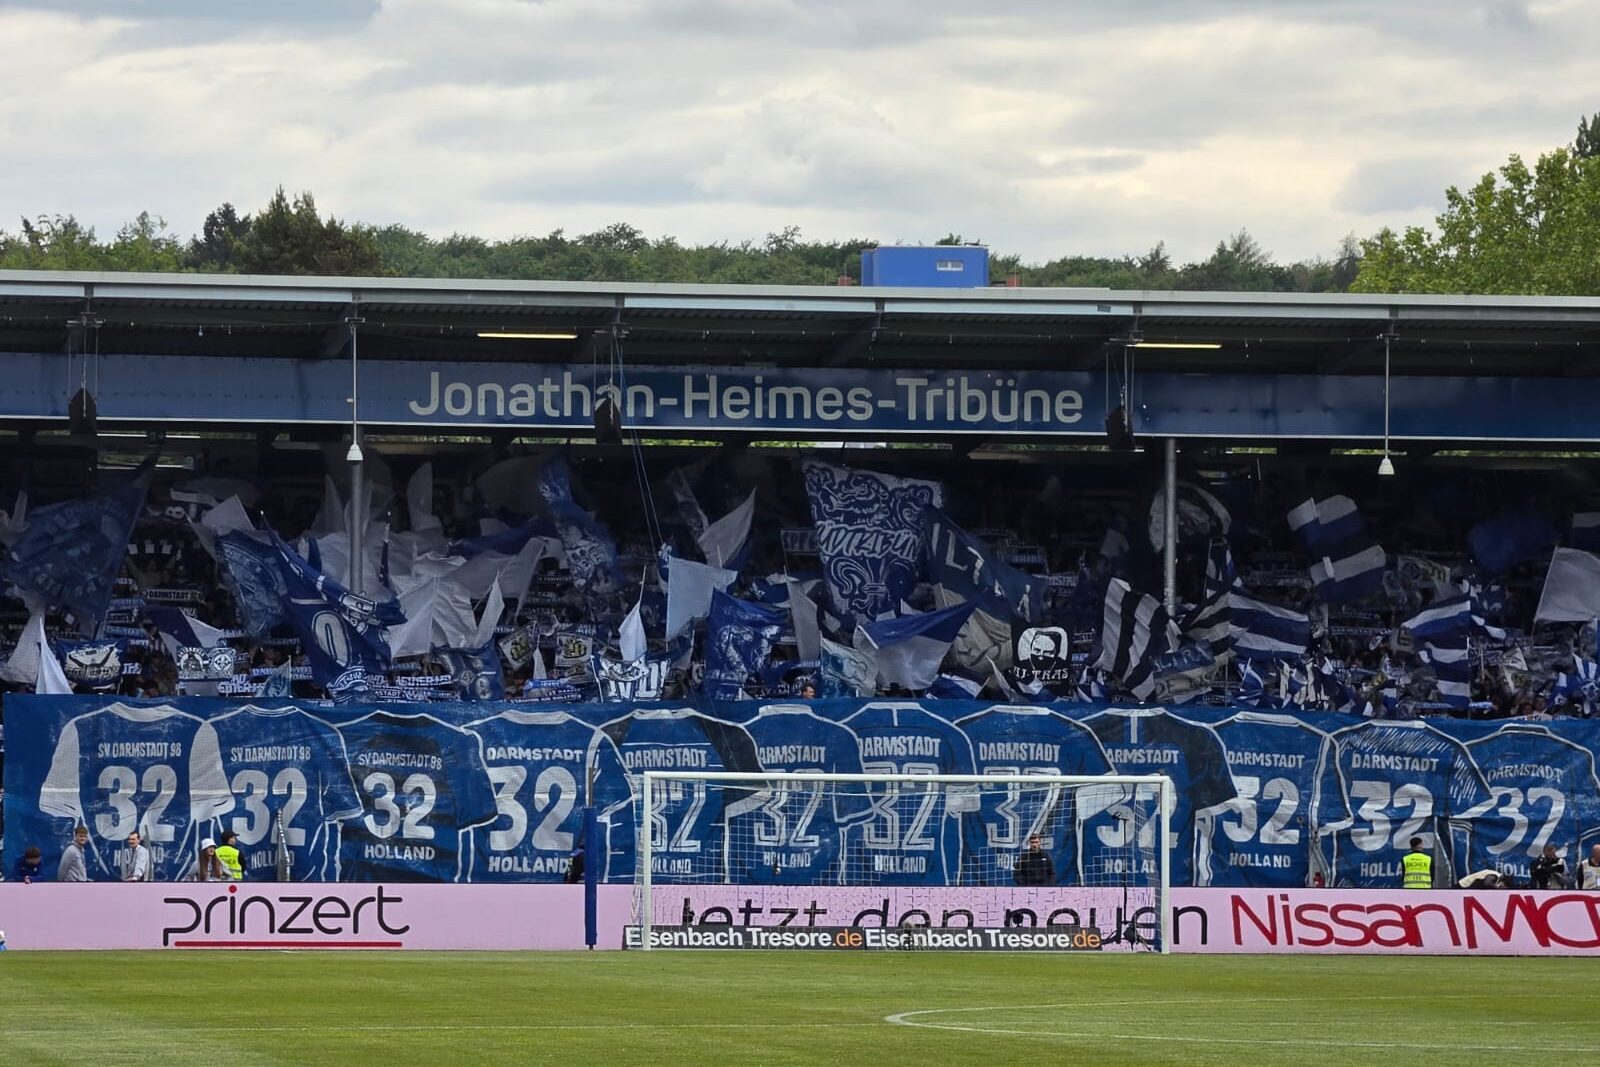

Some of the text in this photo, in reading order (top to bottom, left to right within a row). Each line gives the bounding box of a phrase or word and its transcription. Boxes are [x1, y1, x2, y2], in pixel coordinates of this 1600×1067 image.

[98, 741, 182, 758] SV DARMSTADT 98
[230, 746, 311, 762] SV DARMSTADT 98
[487, 747, 583, 763] DARMSTADT
[624, 749, 707, 768] DARMSTADT
[758, 745, 826, 765] ARMSTADT
[979, 742, 1061, 762] DARMSTADT
[1106, 749, 1179, 764] ARMSTADT
[358, 752, 442, 769] SV DARMSTADT 98
[1351, 753, 1439, 772] DARMSTADT
[1487, 764, 1565, 784] DARMSTADT
[95, 764, 177, 842] 32
[230, 767, 307, 846] 32
[363, 772, 437, 839] 32
[487, 765, 577, 851] 32
[754, 768, 826, 848] 32
[862, 762, 938, 851] 32
[983, 766, 1062, 849] 32
[1222, 776, 1300, 845] 32
[1350, 780, 1434, 851] 32
[1486, 786, 1568, 857] 32
[114, 846, 164, 866] HOND
[251, 850, 295, 870] HOLLD
[364, 843, 436, 861] HOLLAND
[1229, 852, 1291, 869] HOLLAND
[488, 856, 569, 874] HOLLAND
[651, 857, 692, 874] OLLAND
[874, 855, 927, 874] HOLLAND
[1360, 862, 1402, 879] HOLLA
[1495, 861, 1531, 878] HOLL
[164, 885, 410, 946] prinzert
[1230, 893, 1462, 948] Nissan
[1462, 893, 1600, 950] MIC
[746, 927, 863, 948] Tresore.de
[985, 929, 1101, 948] Tresore.de
